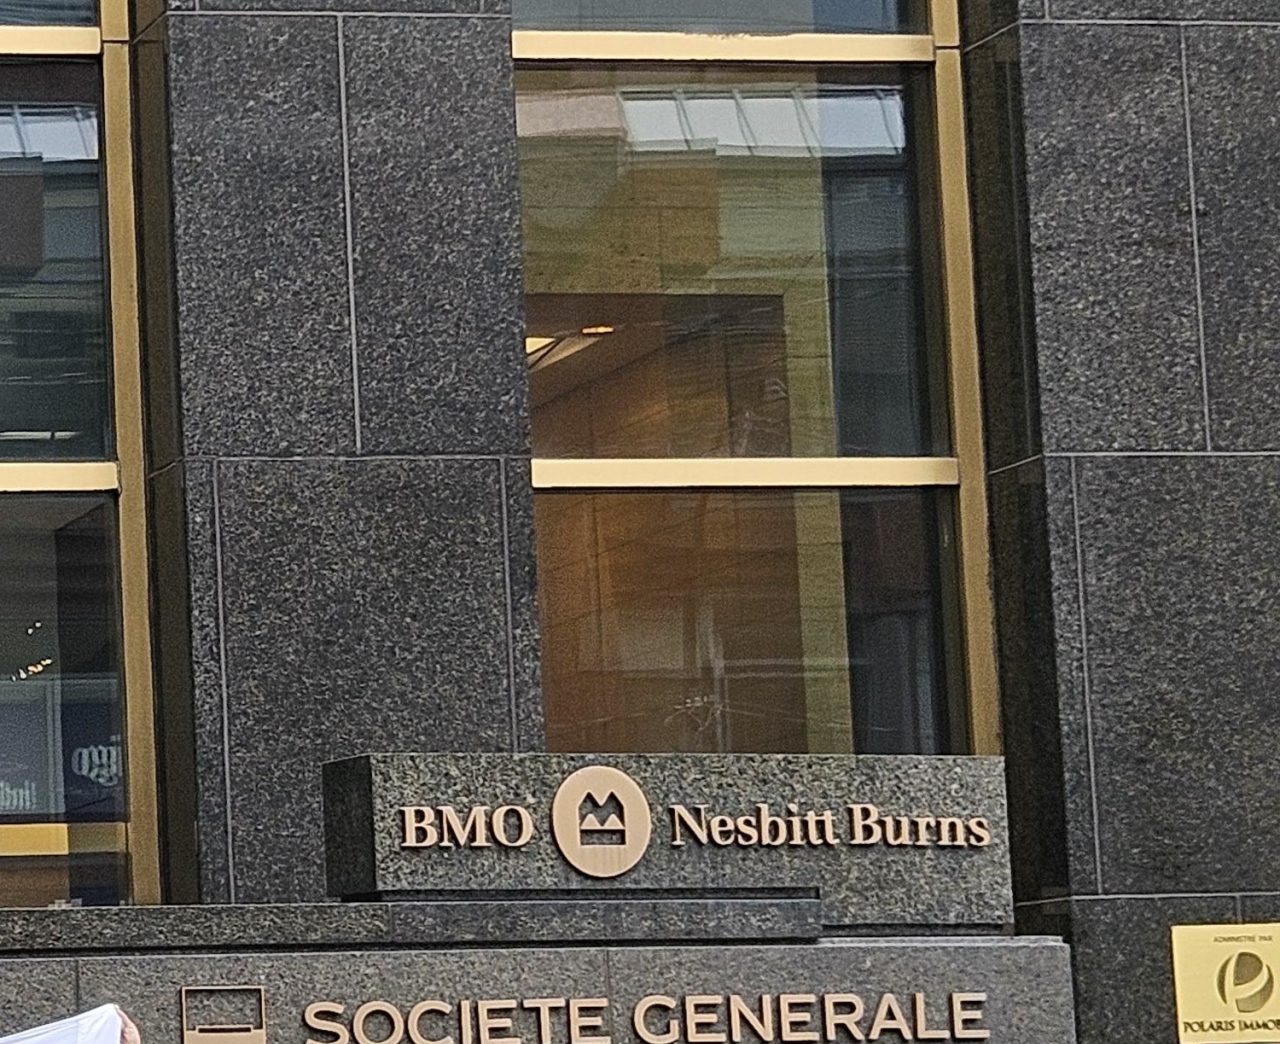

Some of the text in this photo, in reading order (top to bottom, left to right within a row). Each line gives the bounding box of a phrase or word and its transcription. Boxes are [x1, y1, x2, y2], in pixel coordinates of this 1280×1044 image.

[399, 802, 992, 848] BMO Nesbitt Burns
[1183, 1020, 1236, 1033] POLARIS
